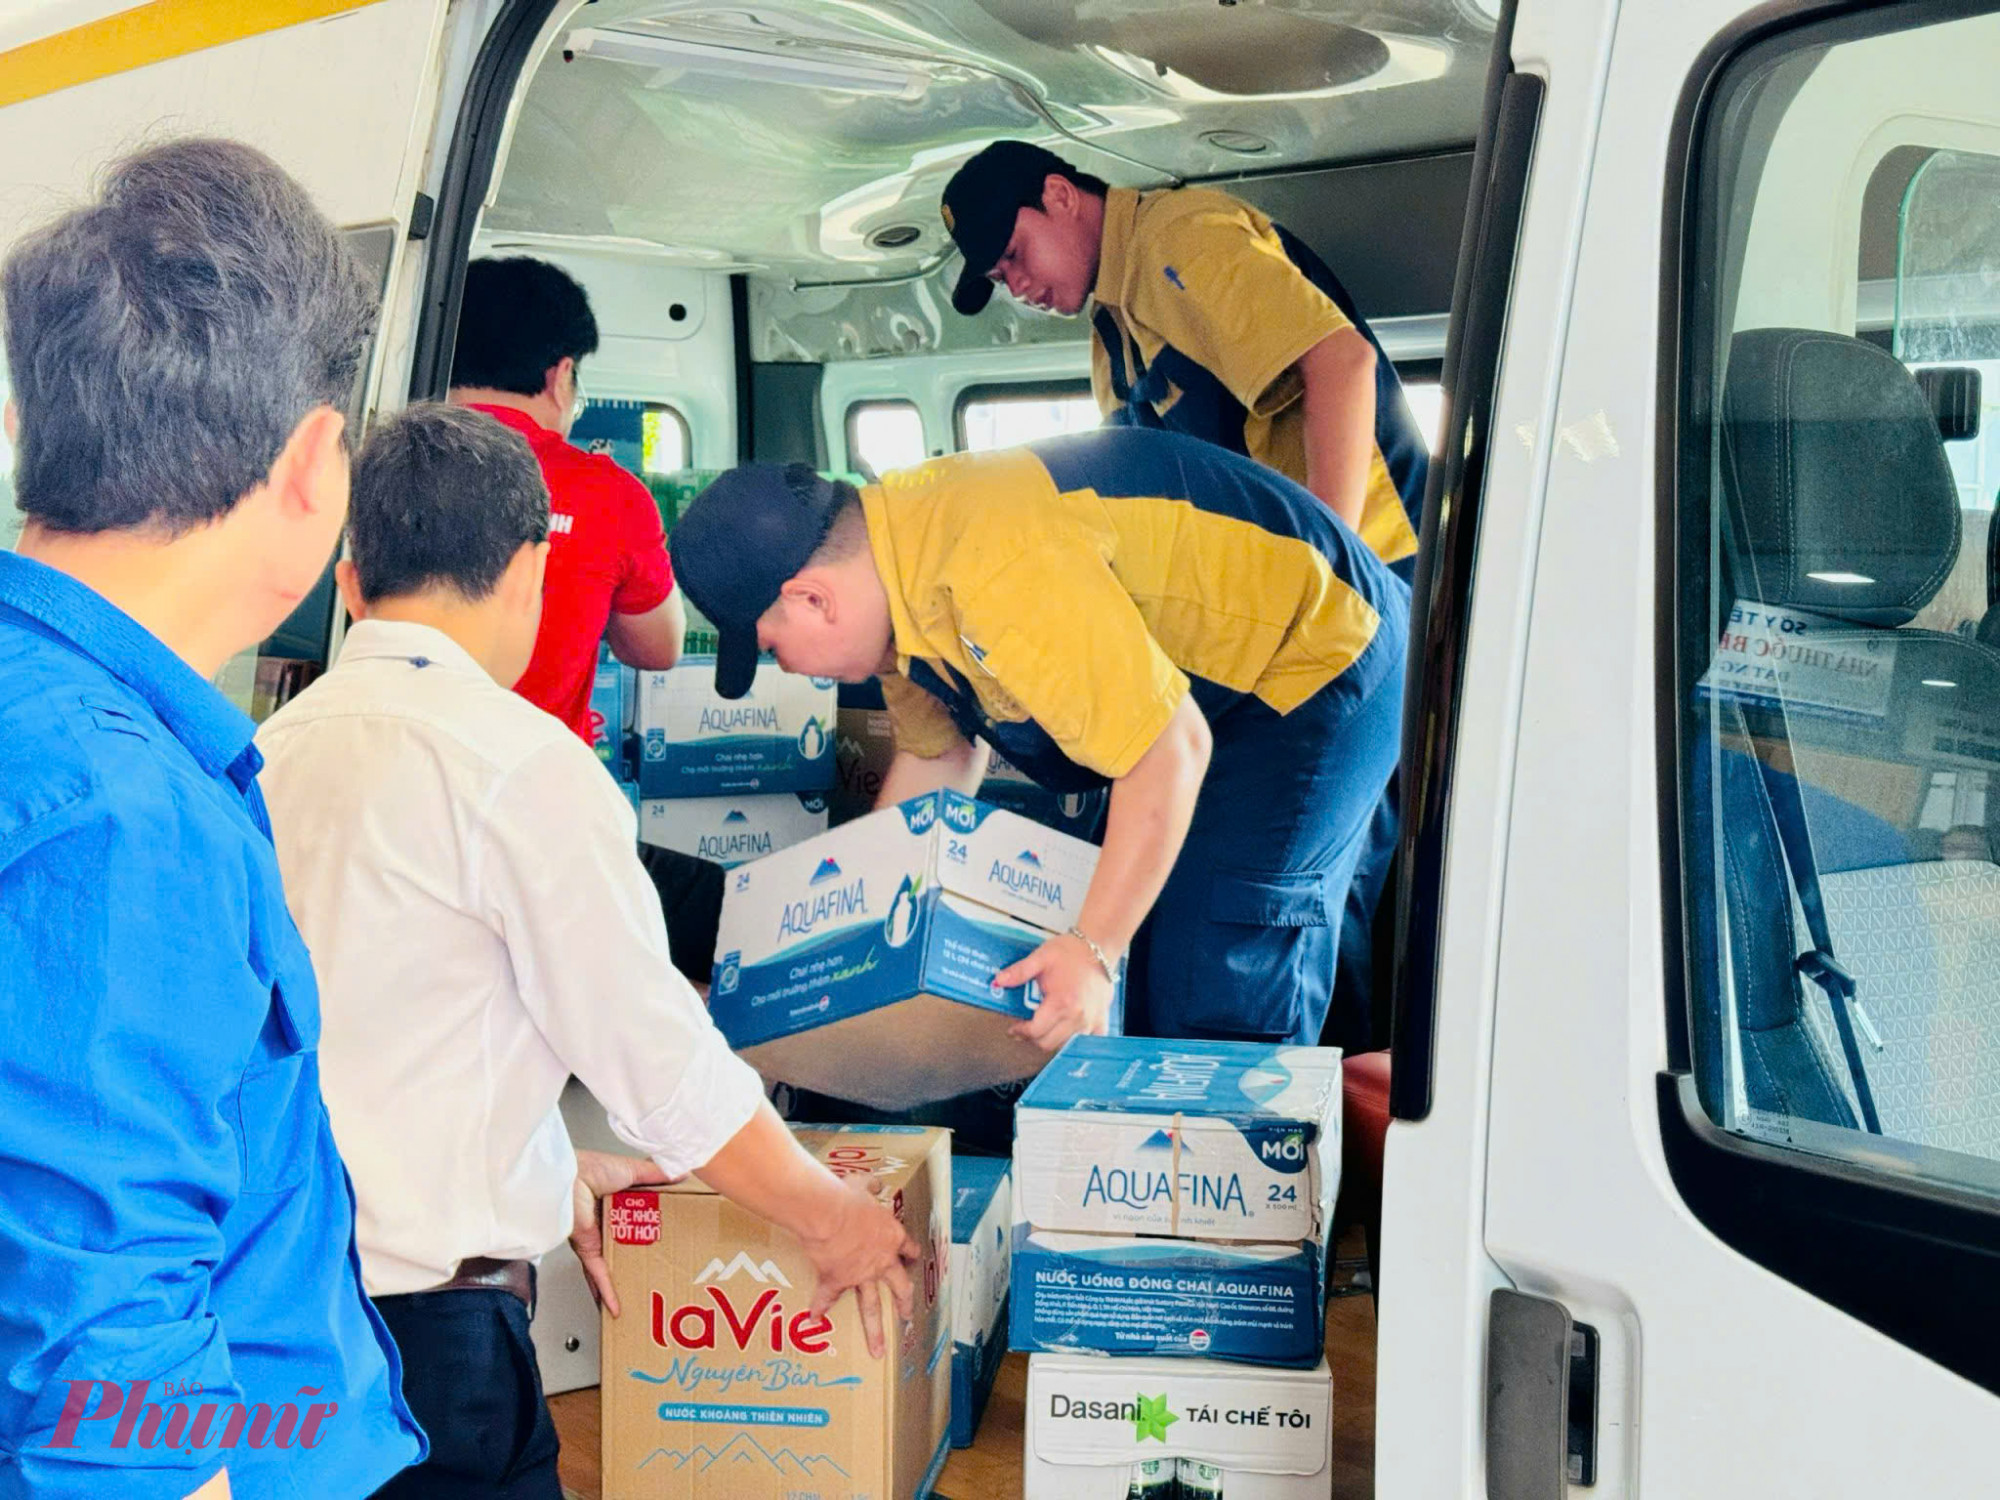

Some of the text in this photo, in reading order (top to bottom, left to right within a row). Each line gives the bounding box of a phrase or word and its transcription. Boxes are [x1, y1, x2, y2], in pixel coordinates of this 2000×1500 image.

[652, 676, 665, 685] 24
[699, 706, 779, 733] AQUAFINA
[652, 805, 665, 815] 24
[698, 831, 772, 859] AQUAFINA
[948, 840, 967, 859] 24
[736, 872, 750, 888] 24
[988, 860, 1064, 910] AQUAFINA
[778, 878, 868, 943] AQUAFINA
[625, 1198, 645, 1207] CHO
[1083, 1164, 1248, 1217] AQUAFINA
[1267, 1184, 1297, 1202] 24
[1036, 1269, 1294, 1298] NƯỚC UỐNG ĐÓNG CHAI AQUAFINA
[651, 1286, 833, 1354] laVie
[664, 1356, 820, 1392] Nguyên Bản
[665, 1406, 823, 1424] NƯỚC KHOÁNG THIÊN NHIÊN
[1050, 1394, 1311, 1430] Dasani TÁI CHẾ TÔI
